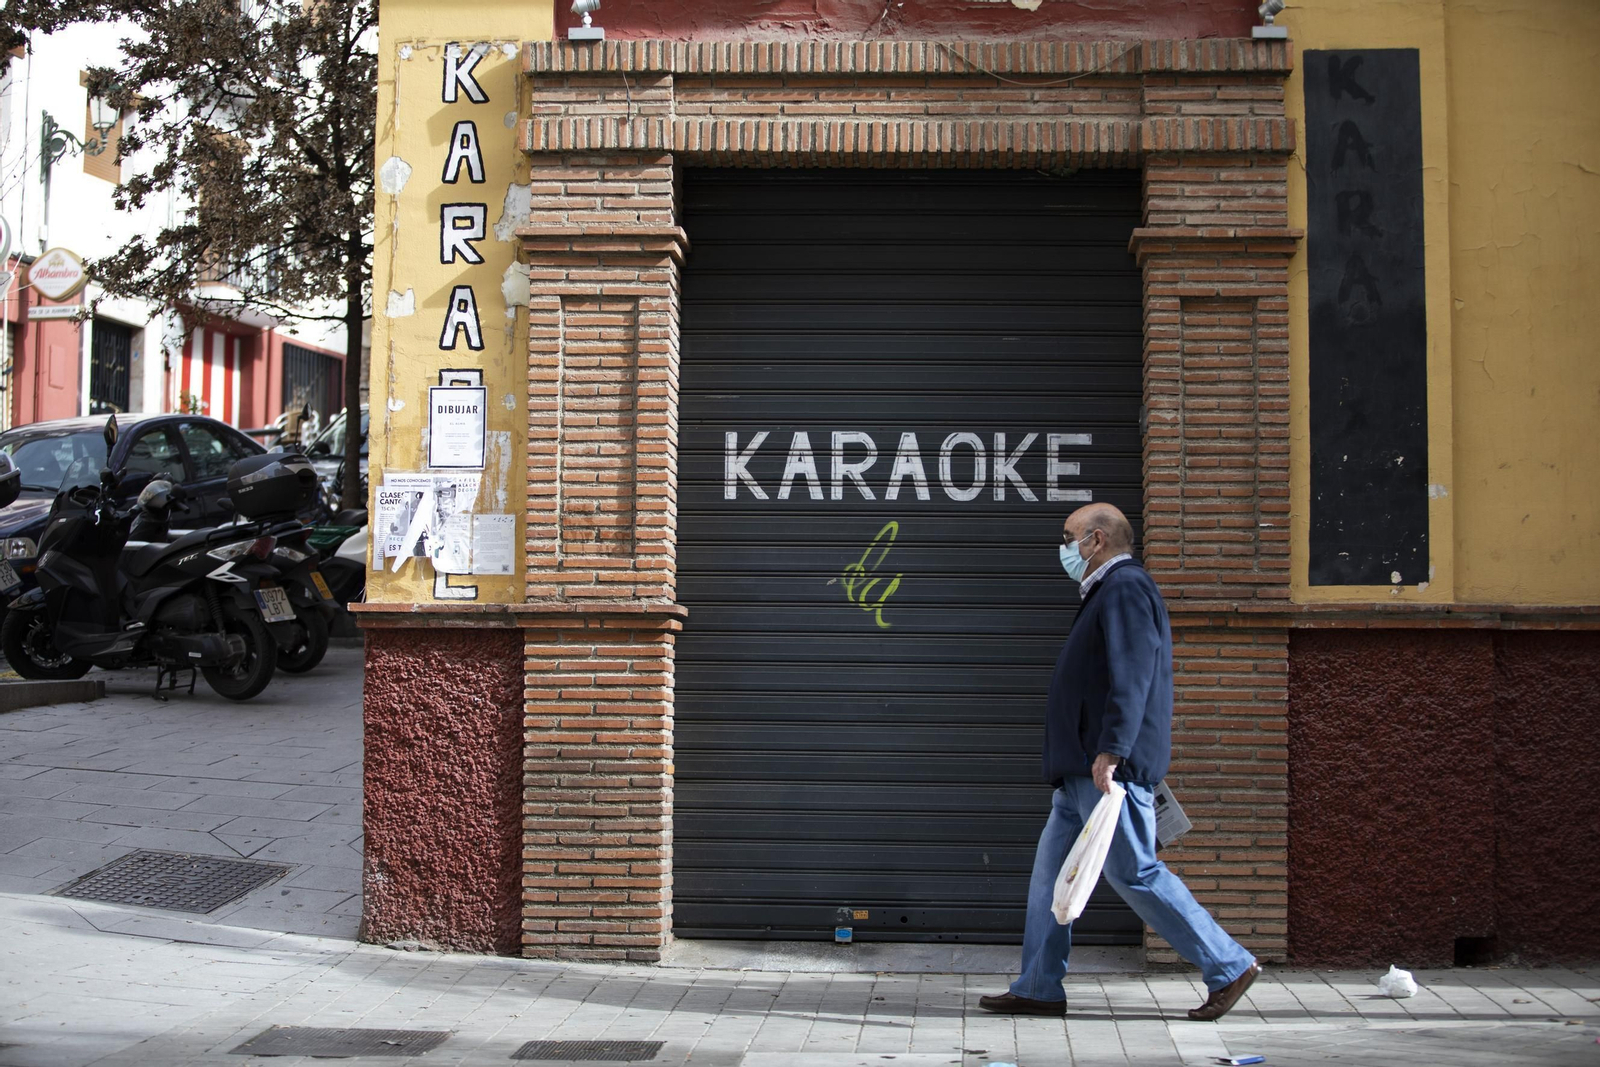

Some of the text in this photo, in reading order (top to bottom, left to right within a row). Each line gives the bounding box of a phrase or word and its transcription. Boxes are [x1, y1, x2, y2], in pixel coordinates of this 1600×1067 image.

[34, 268, 79, 280] Alhambra
[437, 405, 479, 414] DIBUJAR
[724, 431, 1093, 502] KARAOKE
[262, 589, 287, 602] 0972
[266, 602, 286, 616] LBT
